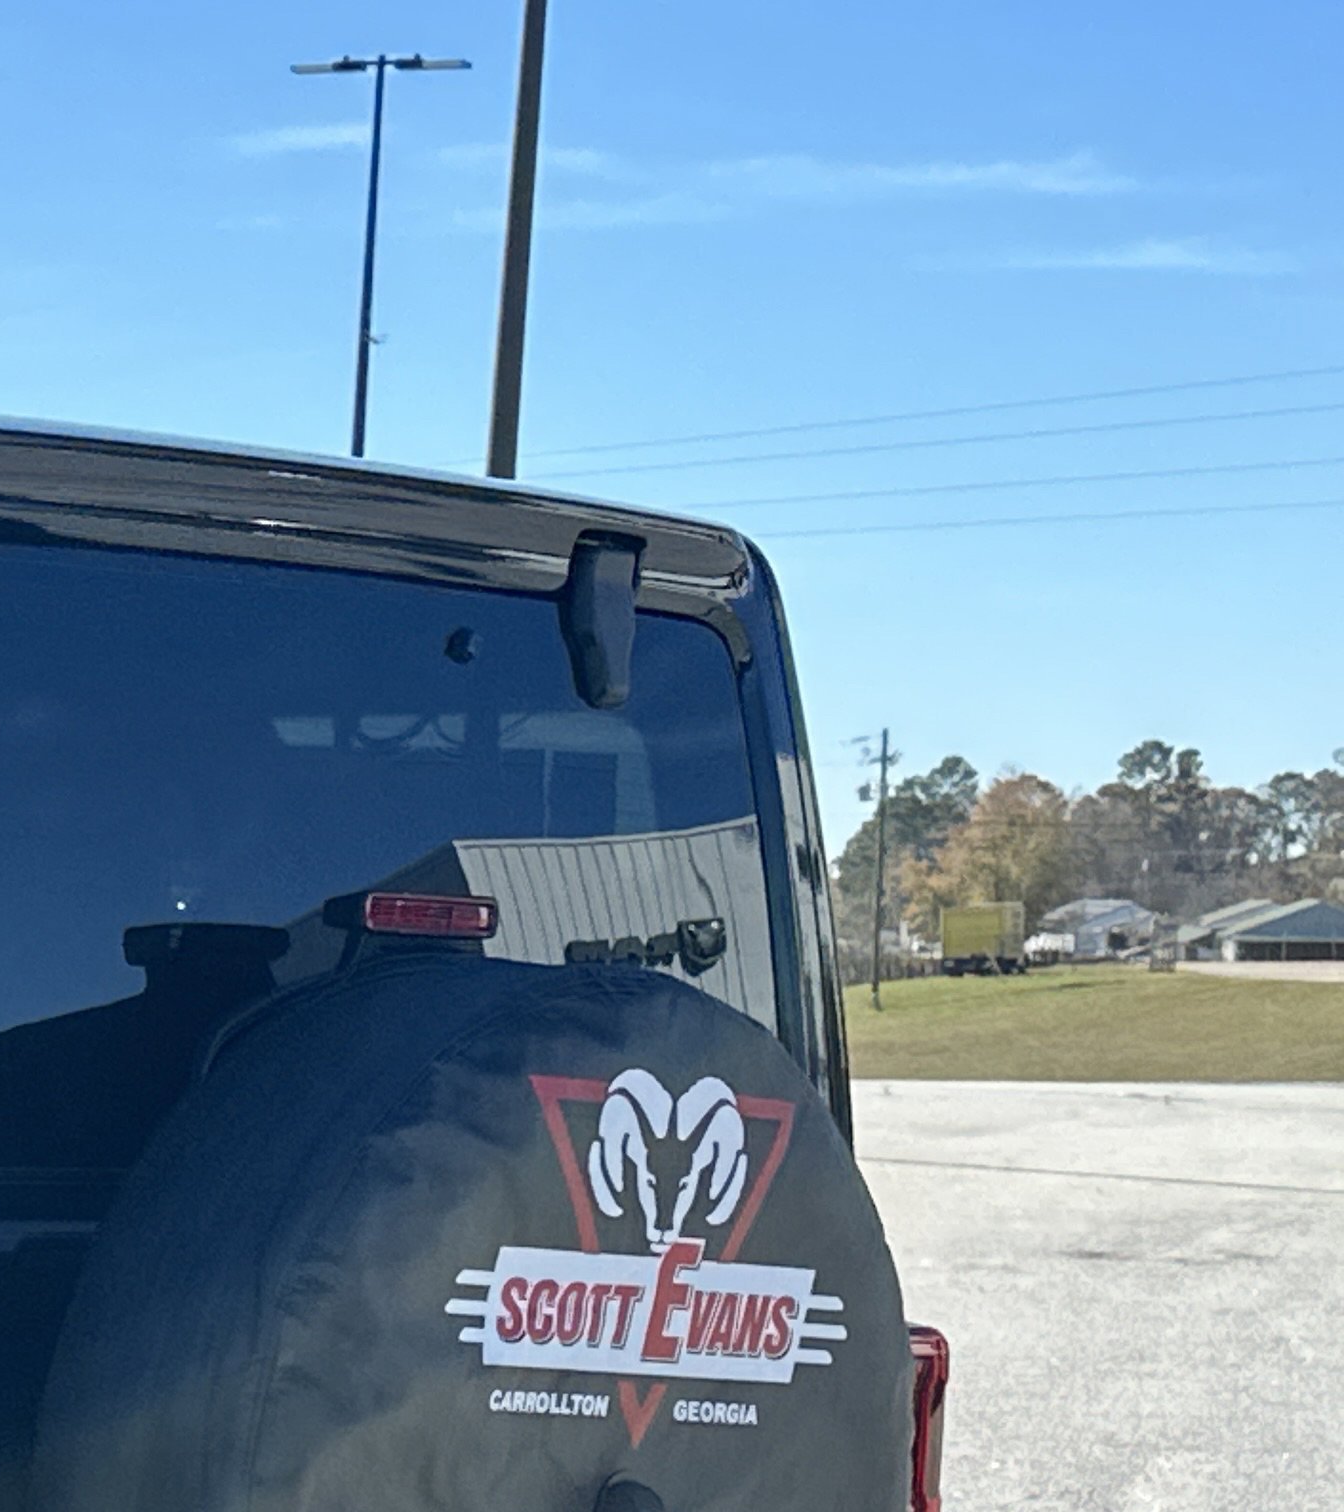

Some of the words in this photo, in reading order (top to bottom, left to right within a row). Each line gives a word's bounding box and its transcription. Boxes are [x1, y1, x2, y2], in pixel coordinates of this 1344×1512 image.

[496, 1276, 644, 1350] SCOTT
[640, 1239, 800, 1363] EVANS
[489, 1389, 610, 1418] CARROLLTON
[672, 1400, 759, 1426] GEORGIA
